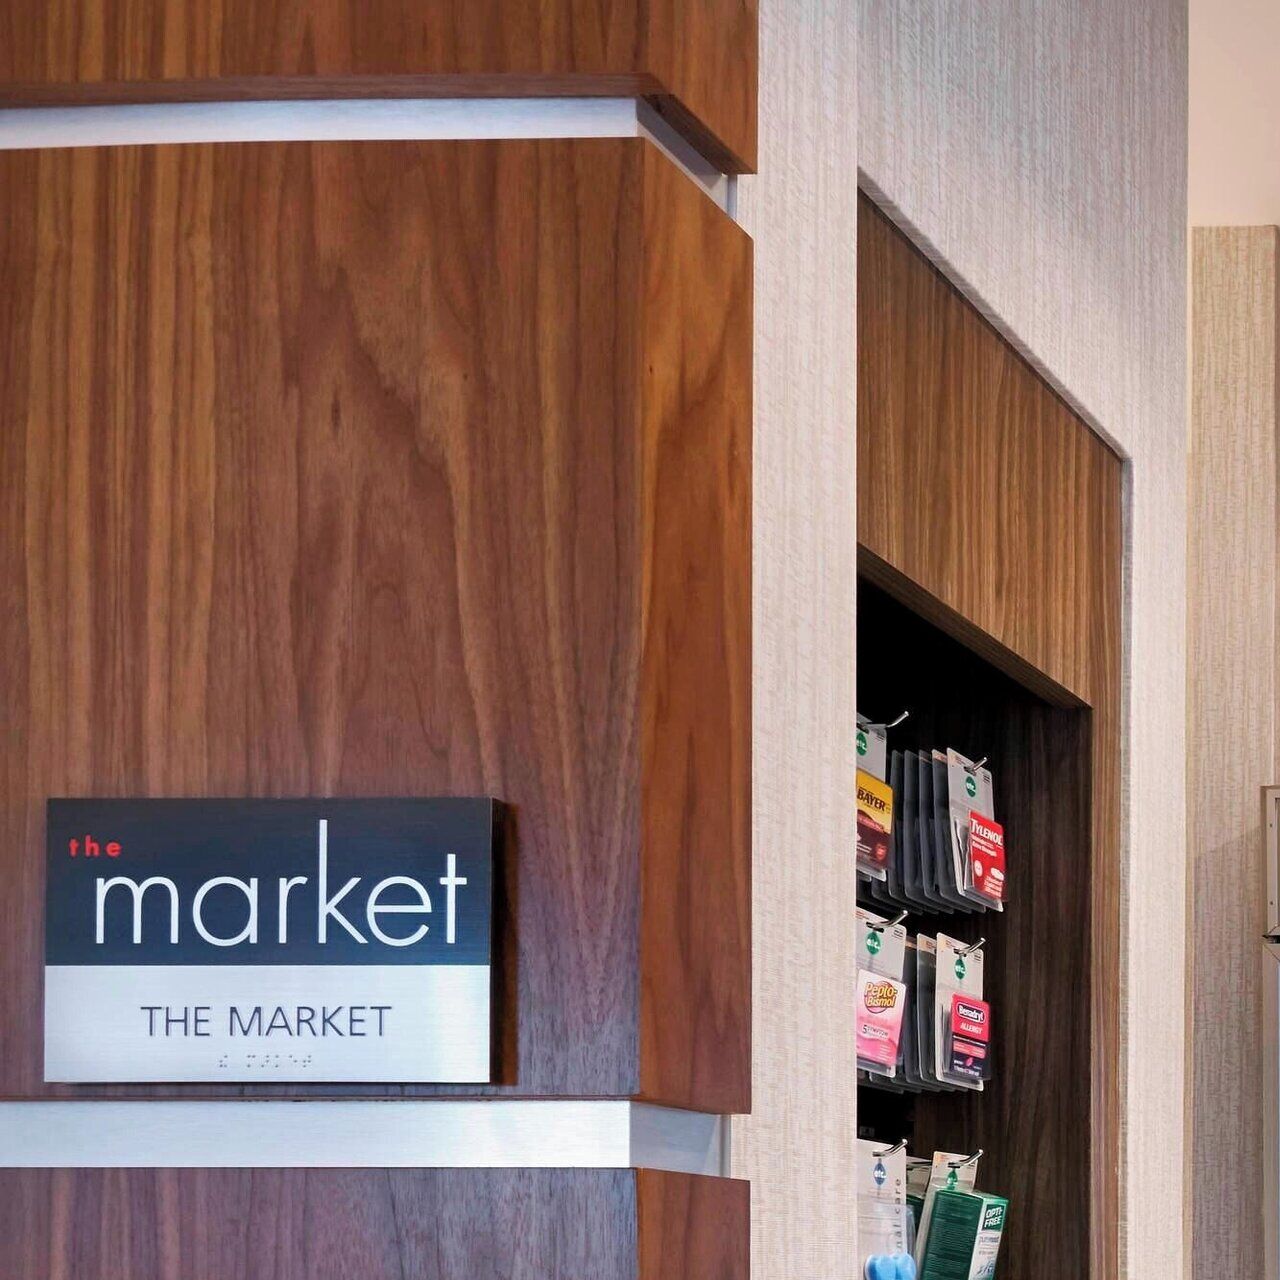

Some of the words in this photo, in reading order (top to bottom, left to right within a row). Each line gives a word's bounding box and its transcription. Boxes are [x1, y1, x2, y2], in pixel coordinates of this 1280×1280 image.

[857, 788, 886, 812] BAYER
[970, 818, 1004, 846] TYLENOL
[69, 835, 123, 858] the
[95, 819, 468, 947] market
[865, 981, 898, 998] Pepto-
[866, 994, 896, 1009] Bismol
[958, 1004, 985, 1021] Benadryl
[140, 1005, 212, 1037] THE
[228, 1005, 393, 1037] MARKET
[984, 1217, 1001, 1230] FREE
